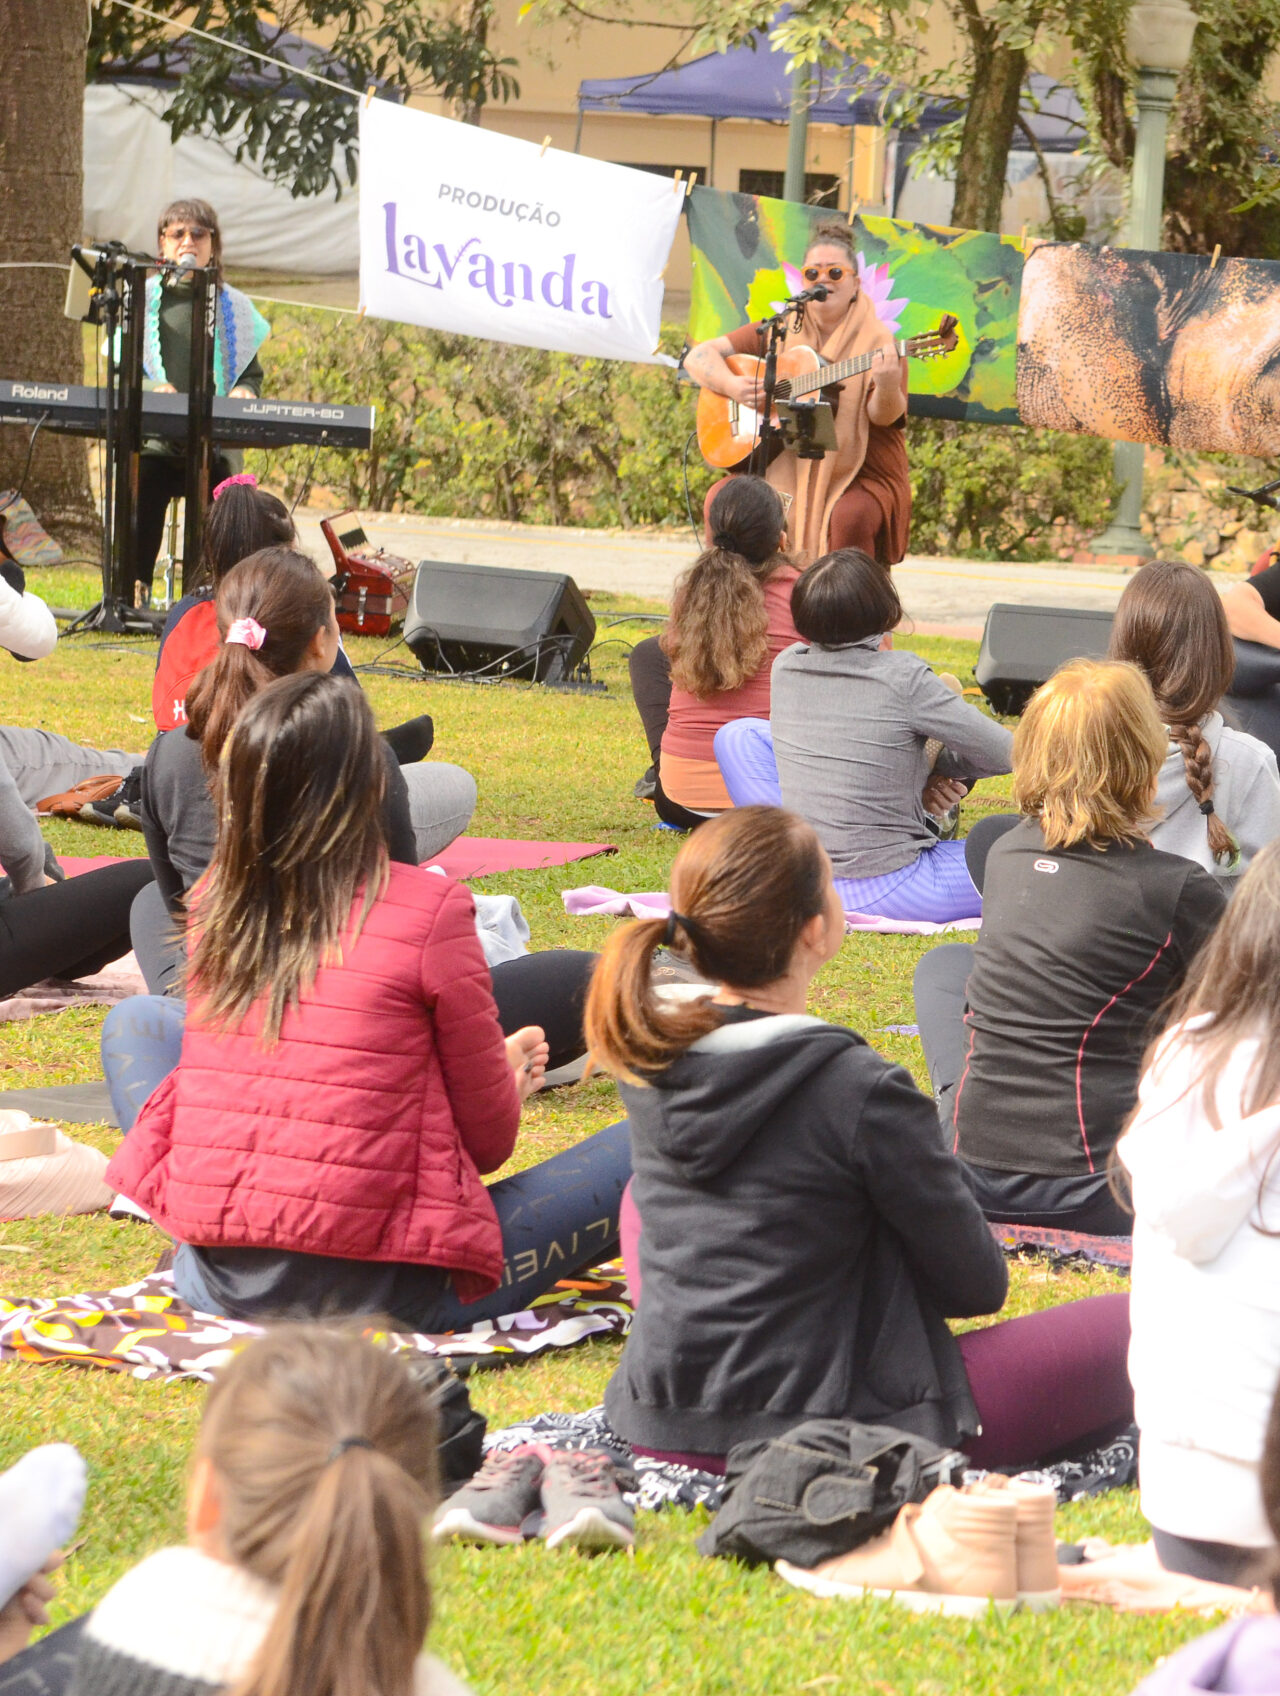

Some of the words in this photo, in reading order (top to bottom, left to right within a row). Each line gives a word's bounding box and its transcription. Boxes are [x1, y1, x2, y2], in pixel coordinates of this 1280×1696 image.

[438, 183, 561, 227] PRODUÇÃO
[11, 383, 69, 401] Roland
[242, 403, 344, 420] JUPITER-80
